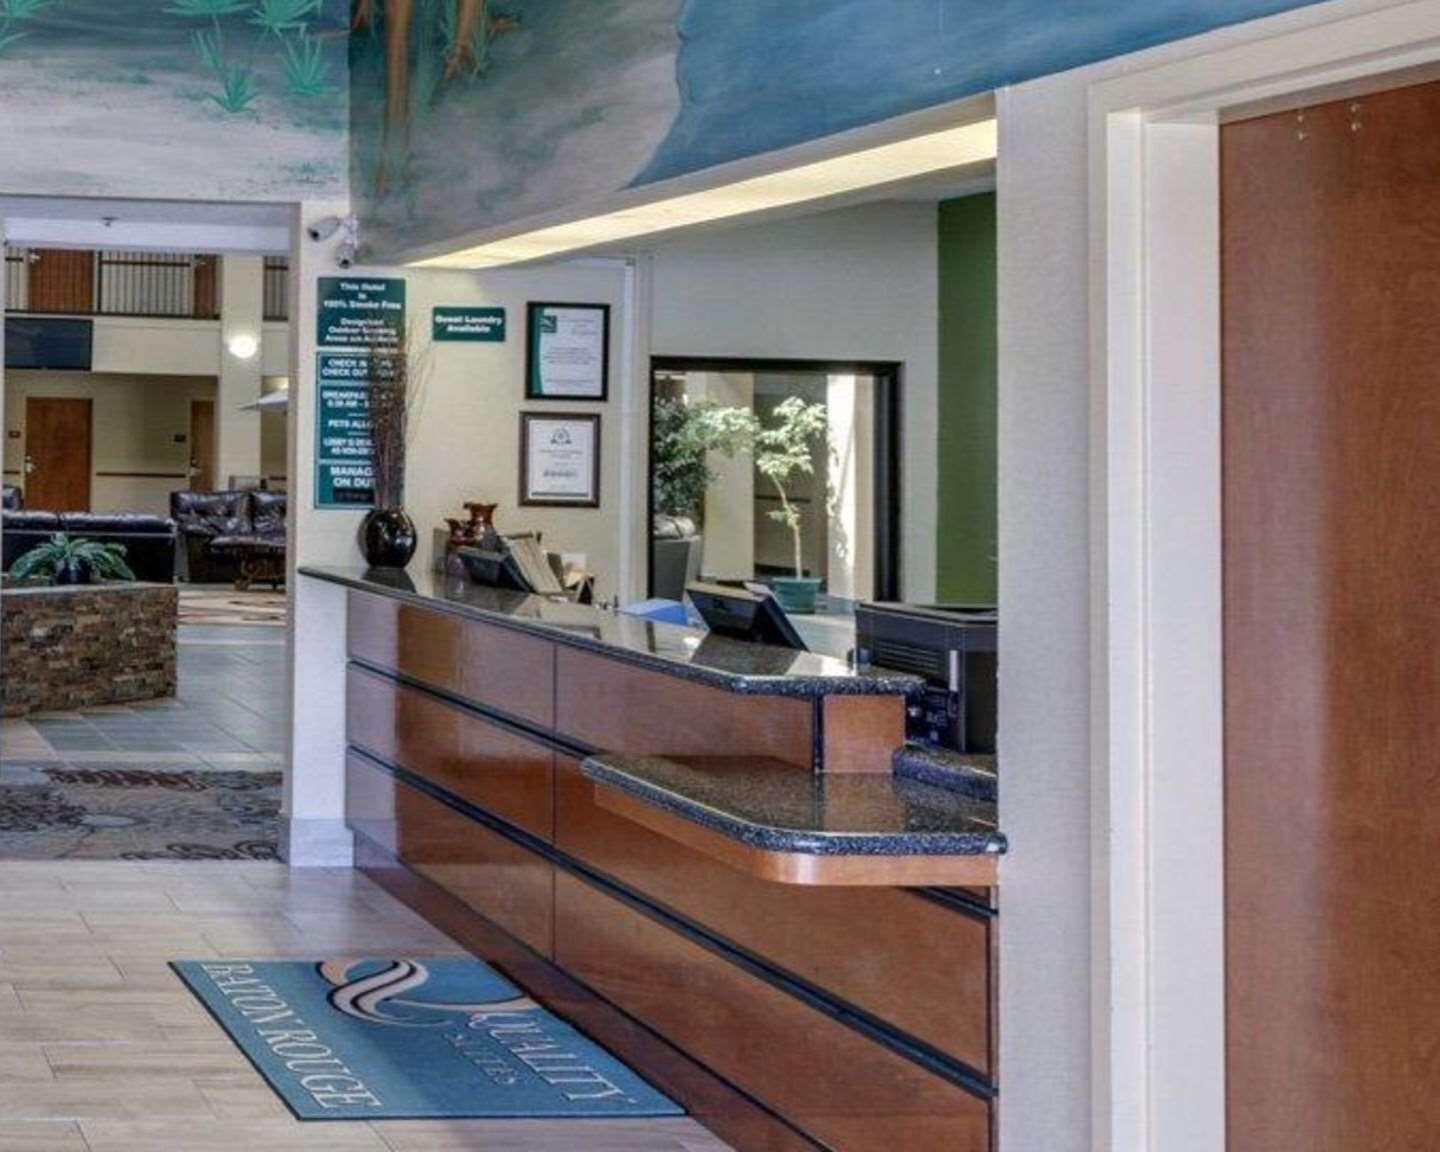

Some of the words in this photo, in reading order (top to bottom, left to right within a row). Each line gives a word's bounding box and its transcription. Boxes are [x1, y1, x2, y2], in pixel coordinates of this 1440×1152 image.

[340, 282, 359, 291] This
[361, 282, 385, 291] Hotel
[323, 299, 347, 309] 100%
[349, 300, 380, 309] Smoke
[382, 300, 402, 310] Free
[435, 314, 463, 324] Guest
[464, 315, 503, 326] Laundry
[447, 323, 491, 333] Available
[327, 358, 357, 368] CHECK
[322, 368, 351, 377] CHECK
[330, 465, 374, 477] MANAG
[332, 478, 352, 488] ON
[201, 963, 304, 1024] BATON
[257, 1027, 383, 1109] ROUGE
[468, 1012, 625, 1100] QUALITY
